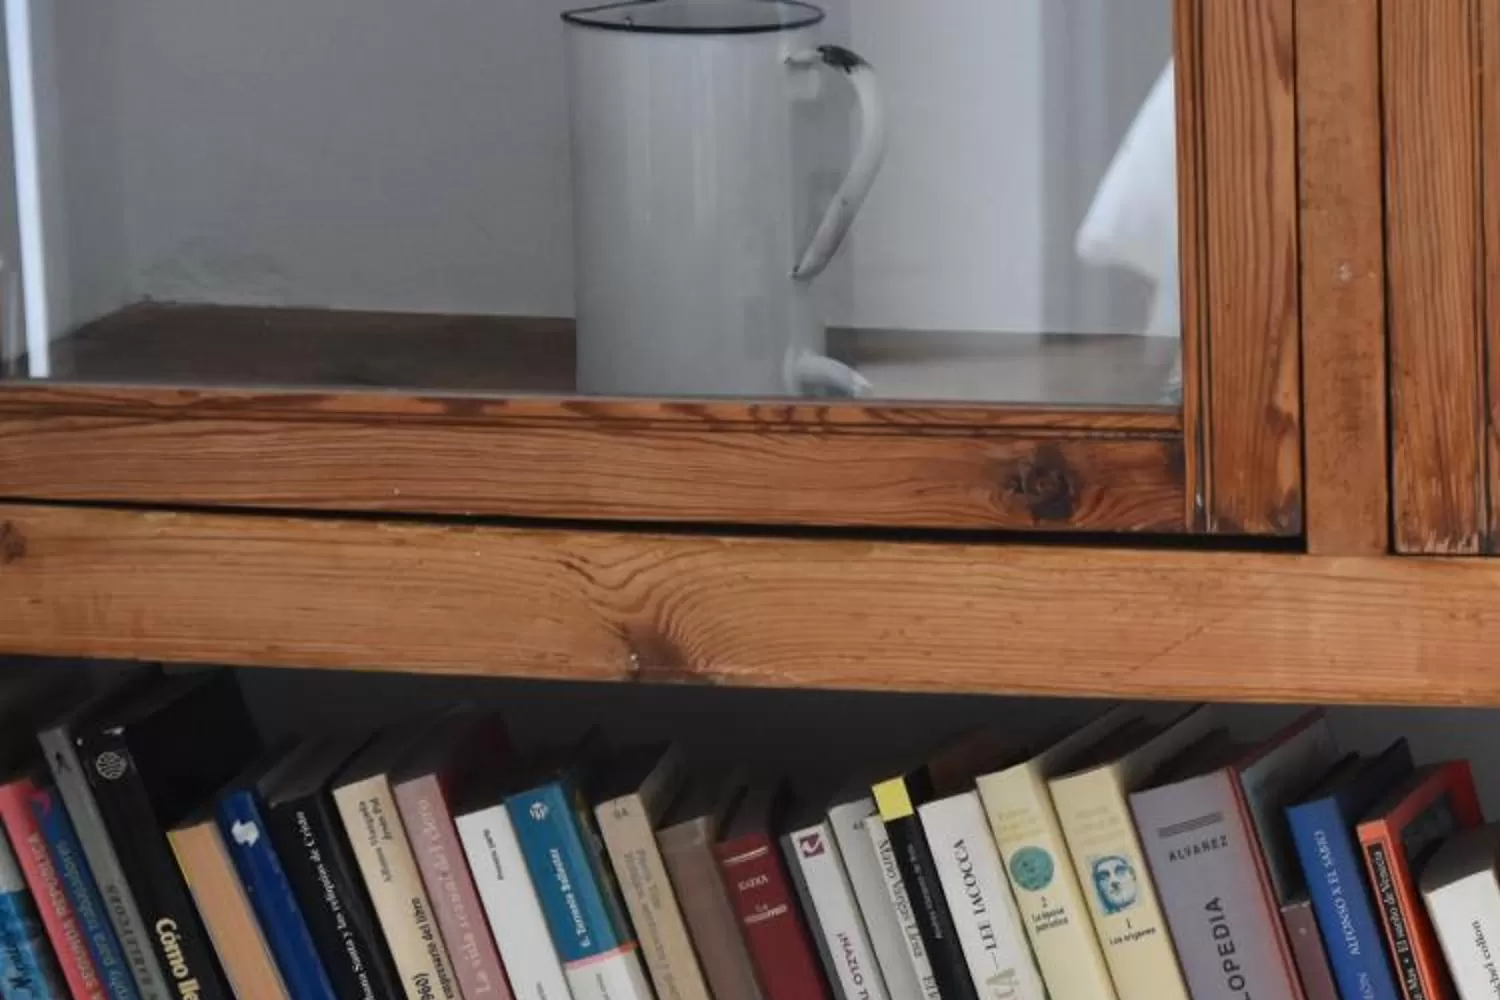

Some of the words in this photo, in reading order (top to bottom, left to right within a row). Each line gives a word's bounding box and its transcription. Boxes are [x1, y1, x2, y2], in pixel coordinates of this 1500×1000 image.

[1314, 829, 1333, 868] SABIO
[953, 838, 985, 914] IACOCCA
[1326, 868, 1339, 884] EL
[1331, 885, 1341, 896] X
[408, 897, 427, 923] libro
[418, 923, 433, 942] del
[978, 922, 997, 950] LEE
[1334, 897, 1360, 955] ALFONSO
[1471, 920, 1491, 960] collon
[155, 917, 188, 978] Cómo
[345, 938, 362, 972] Santa
[473, 970, 491, 993] La
